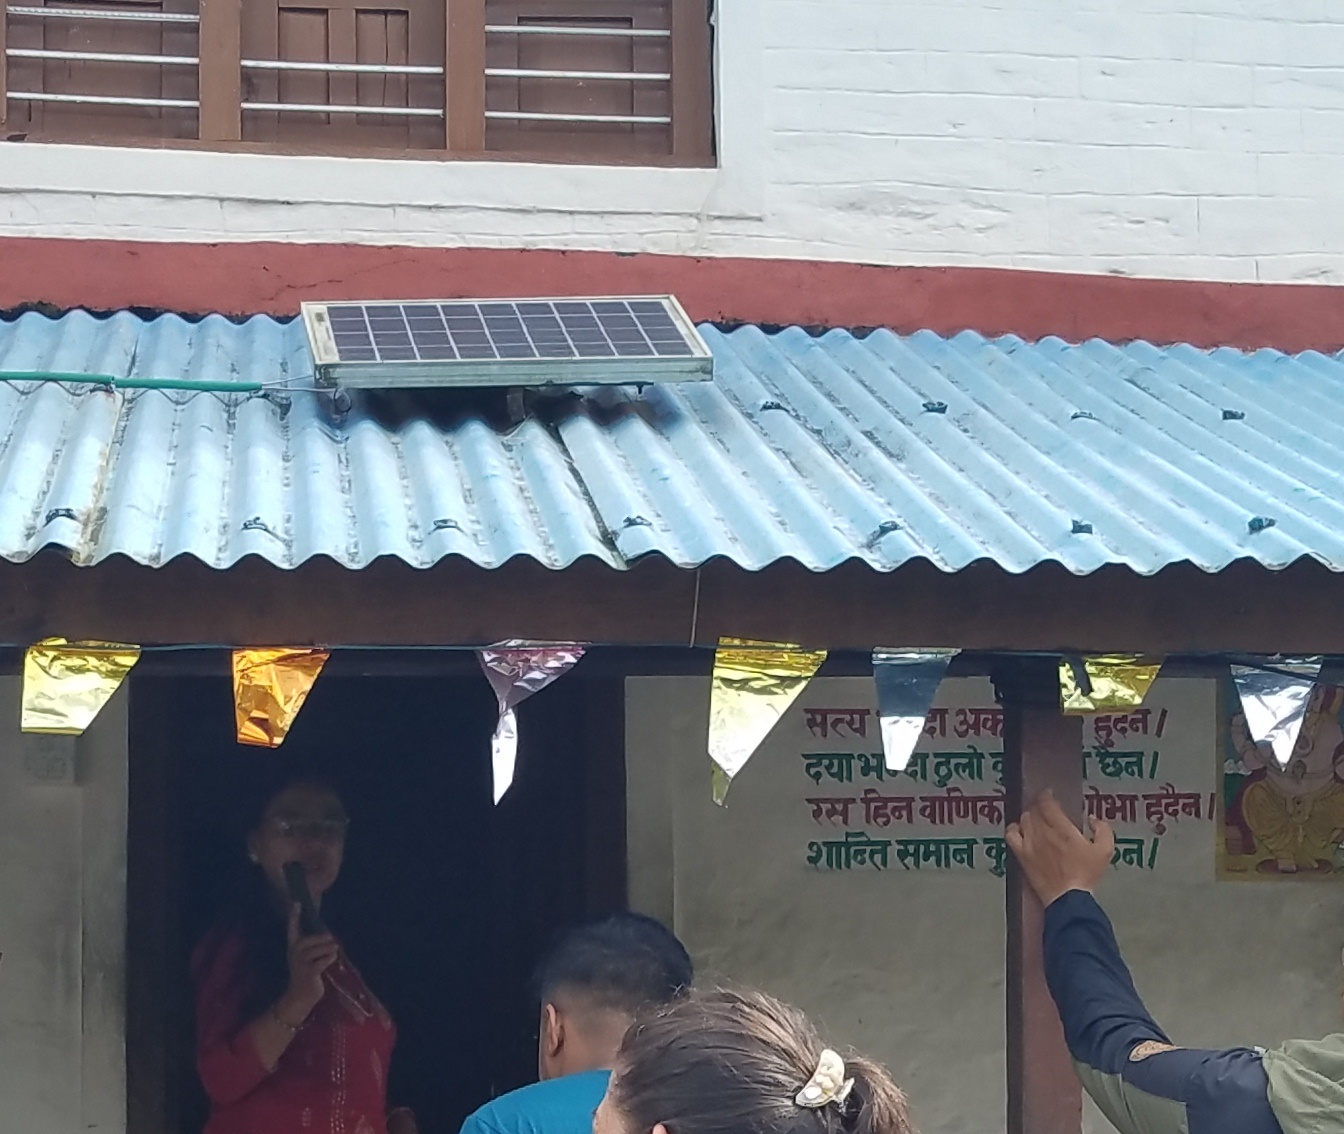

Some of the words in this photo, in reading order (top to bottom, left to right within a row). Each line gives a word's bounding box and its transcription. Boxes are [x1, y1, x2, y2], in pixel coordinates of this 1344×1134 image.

[803, 708, 870, 739] सत्य
[801, 753, 854, 785] दया
[805, 797, 856, 827] रस
[860, 788, 915, 828] हिन
[895, 838, 979, 870] समान
